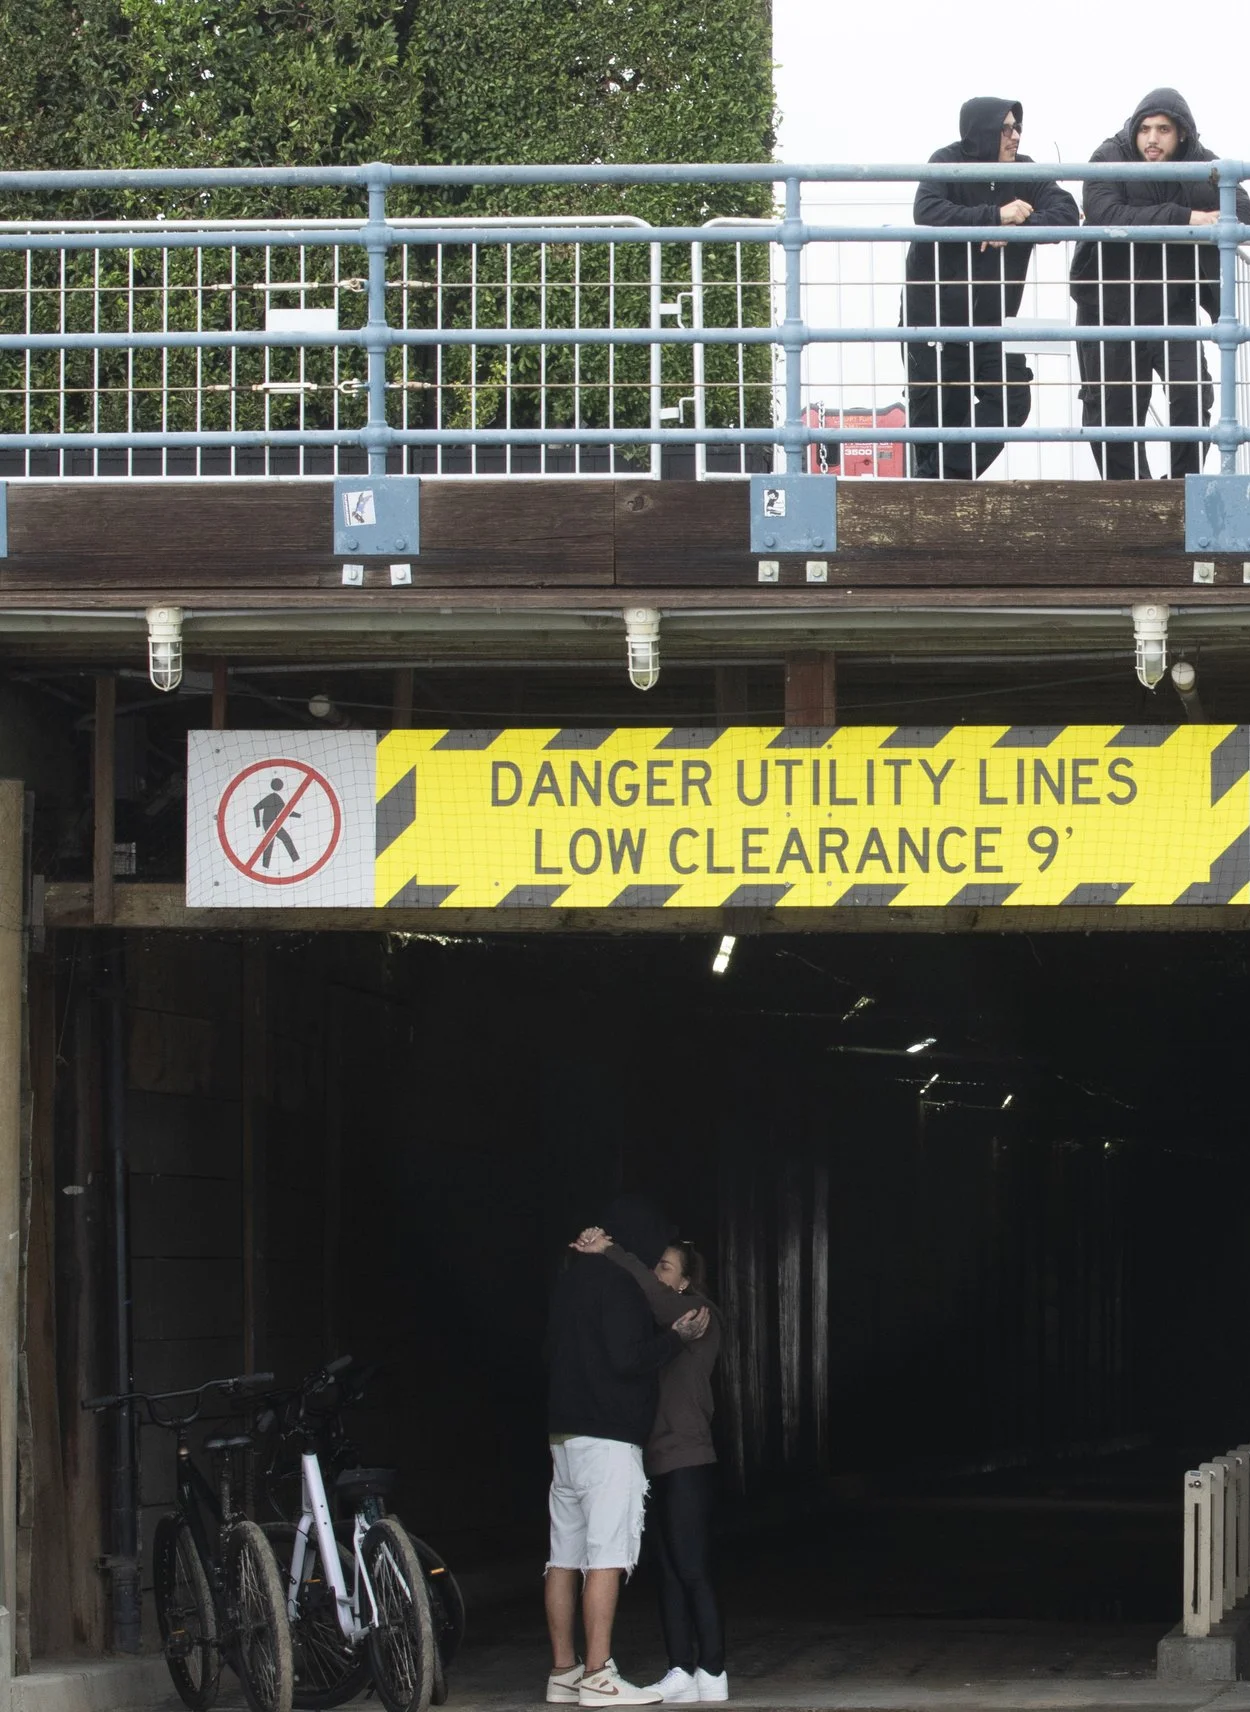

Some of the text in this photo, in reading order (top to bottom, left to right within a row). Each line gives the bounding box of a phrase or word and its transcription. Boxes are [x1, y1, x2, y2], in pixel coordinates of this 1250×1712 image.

[491, 757, 1137, 807] DANGER UTILITY LINES
[534, 826, 1073, 875] LOW CLEARANCE 9'
